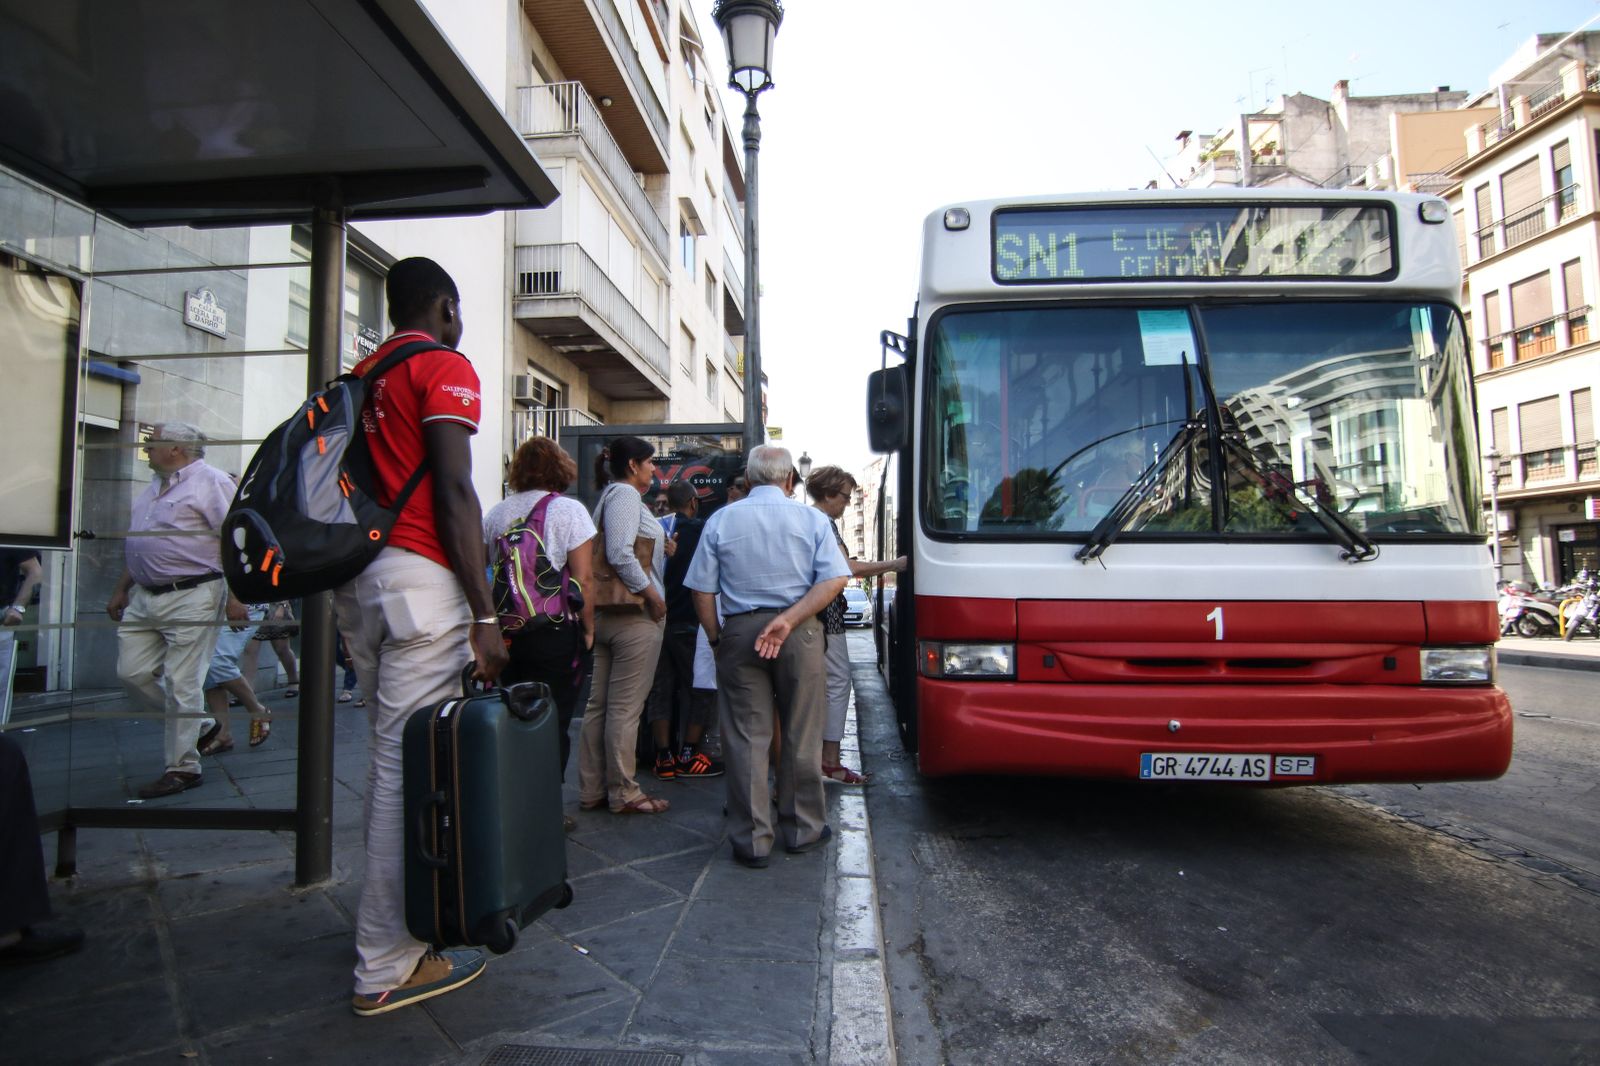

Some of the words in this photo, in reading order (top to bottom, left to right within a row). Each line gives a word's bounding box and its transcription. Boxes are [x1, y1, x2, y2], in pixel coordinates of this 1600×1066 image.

[1112, 229, 1135, 251] E.
[1147, 229, 1178, 251] DE
[997, 233, 1084, 277] SN1
[1120, 255, 1224, 277] CENTRO
[194, 314, 219, 328] DARRO
[356, 335, 378, 352] VENDE
[1206, 607, 1224, 640] 1
[1152, 756, 1178, 777] GR
[1184, 757, 1235, 778] 4744
[1240, 758, 1266, 778] AS
